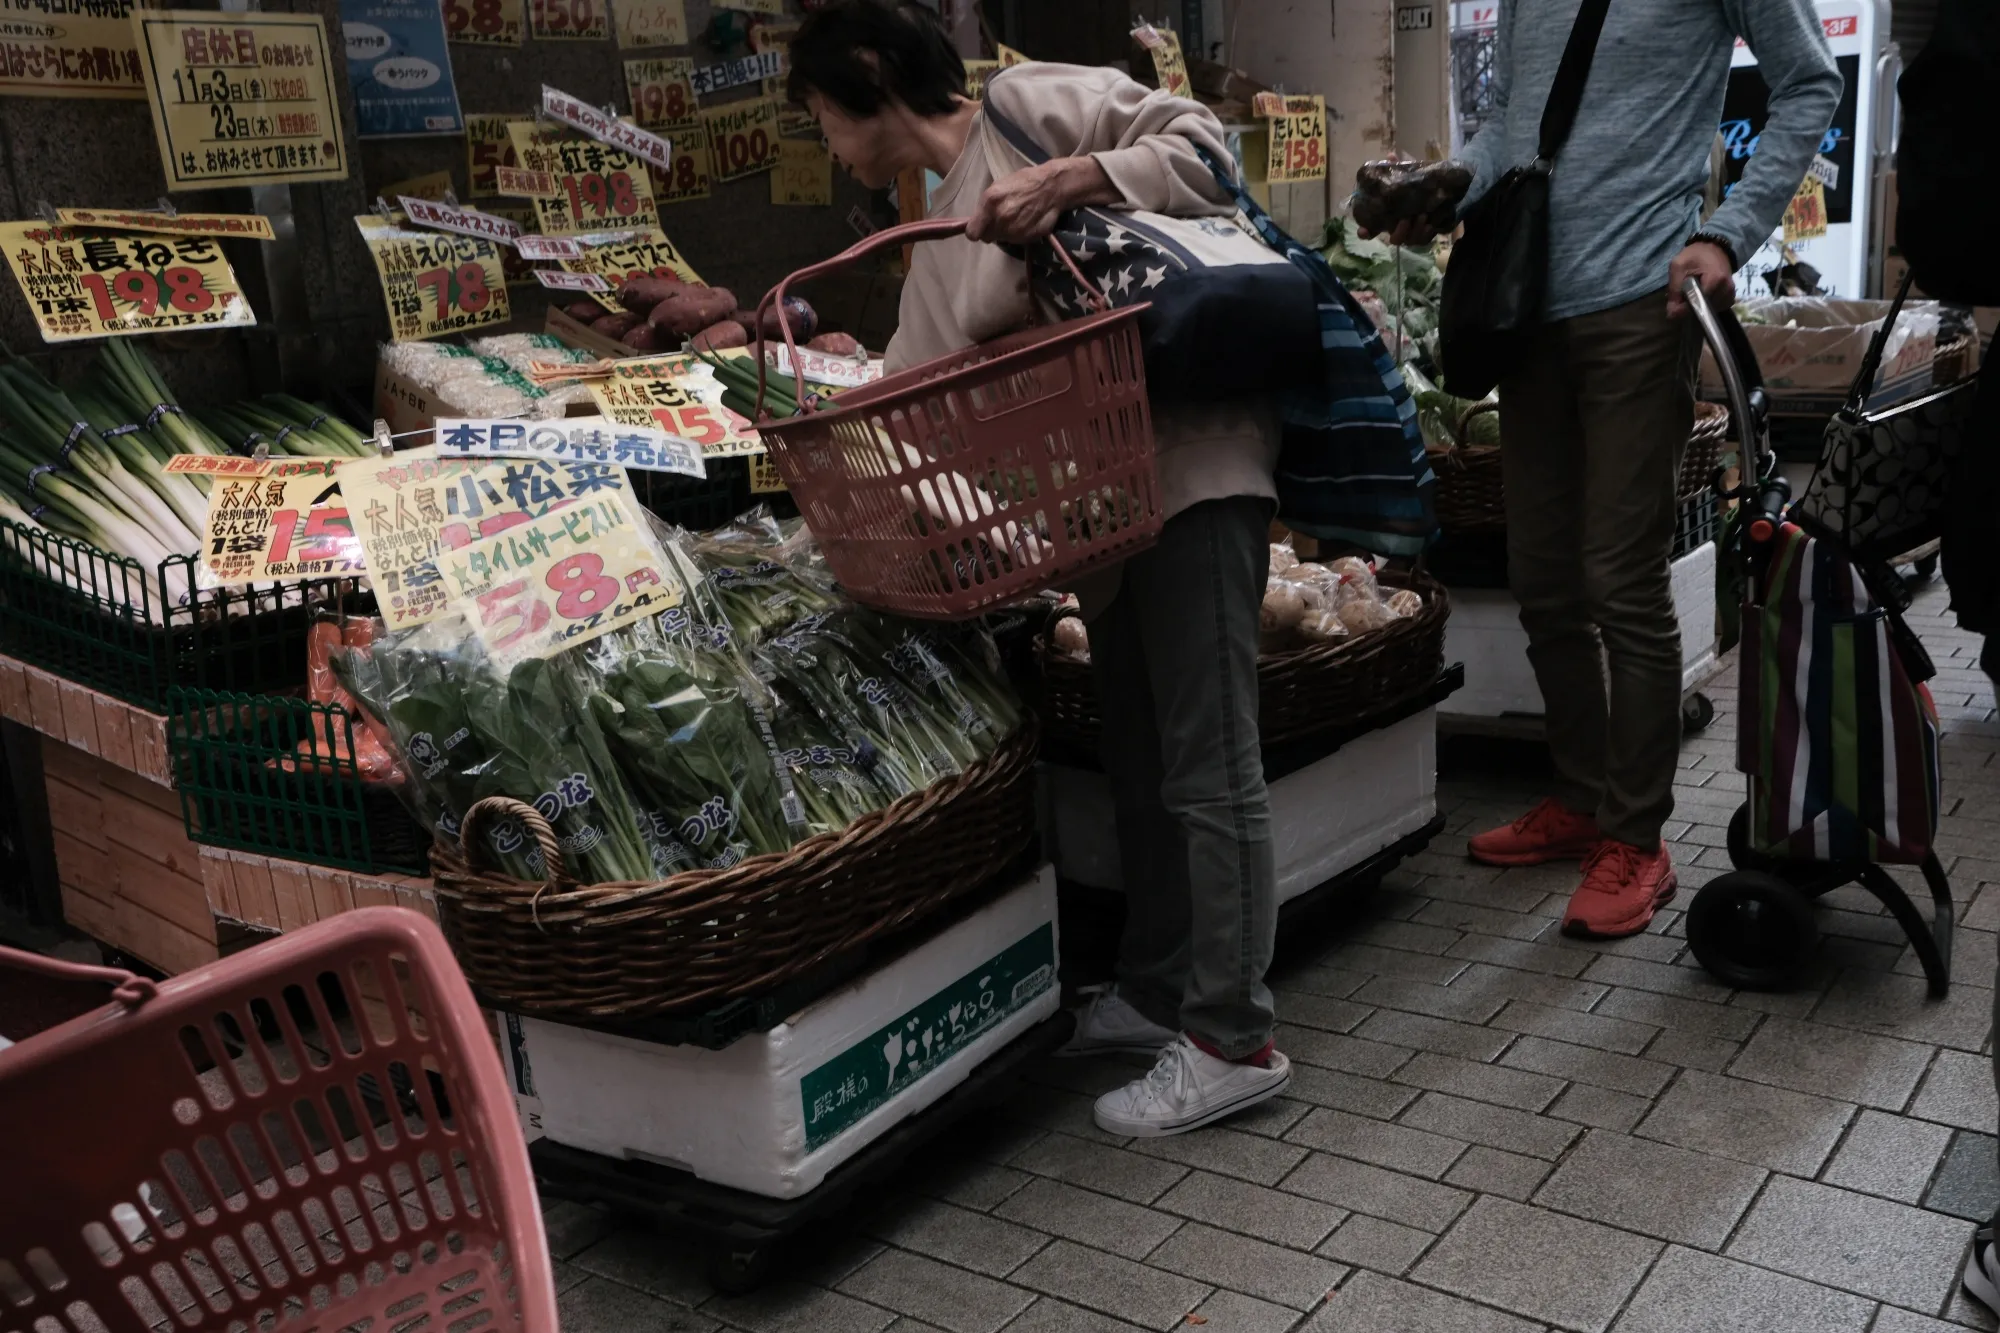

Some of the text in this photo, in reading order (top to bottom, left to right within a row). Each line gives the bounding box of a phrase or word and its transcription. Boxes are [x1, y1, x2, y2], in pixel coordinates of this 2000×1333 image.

[442, 423, 698, 470] 本日の特売品
[220, 480, 288, 509] 大人気
[445, 461, 624, 519] 小松菜
[211, 508, 273, 521] (税別価格)
[363, 487, 445, 537] 大人気
[211, 518, 269, 536] なんと!!
[211, 535, 268, 555] 1袋
[373, 540, 440, 571] なんと!!
[393, 601, 449, 622] アキダイ
